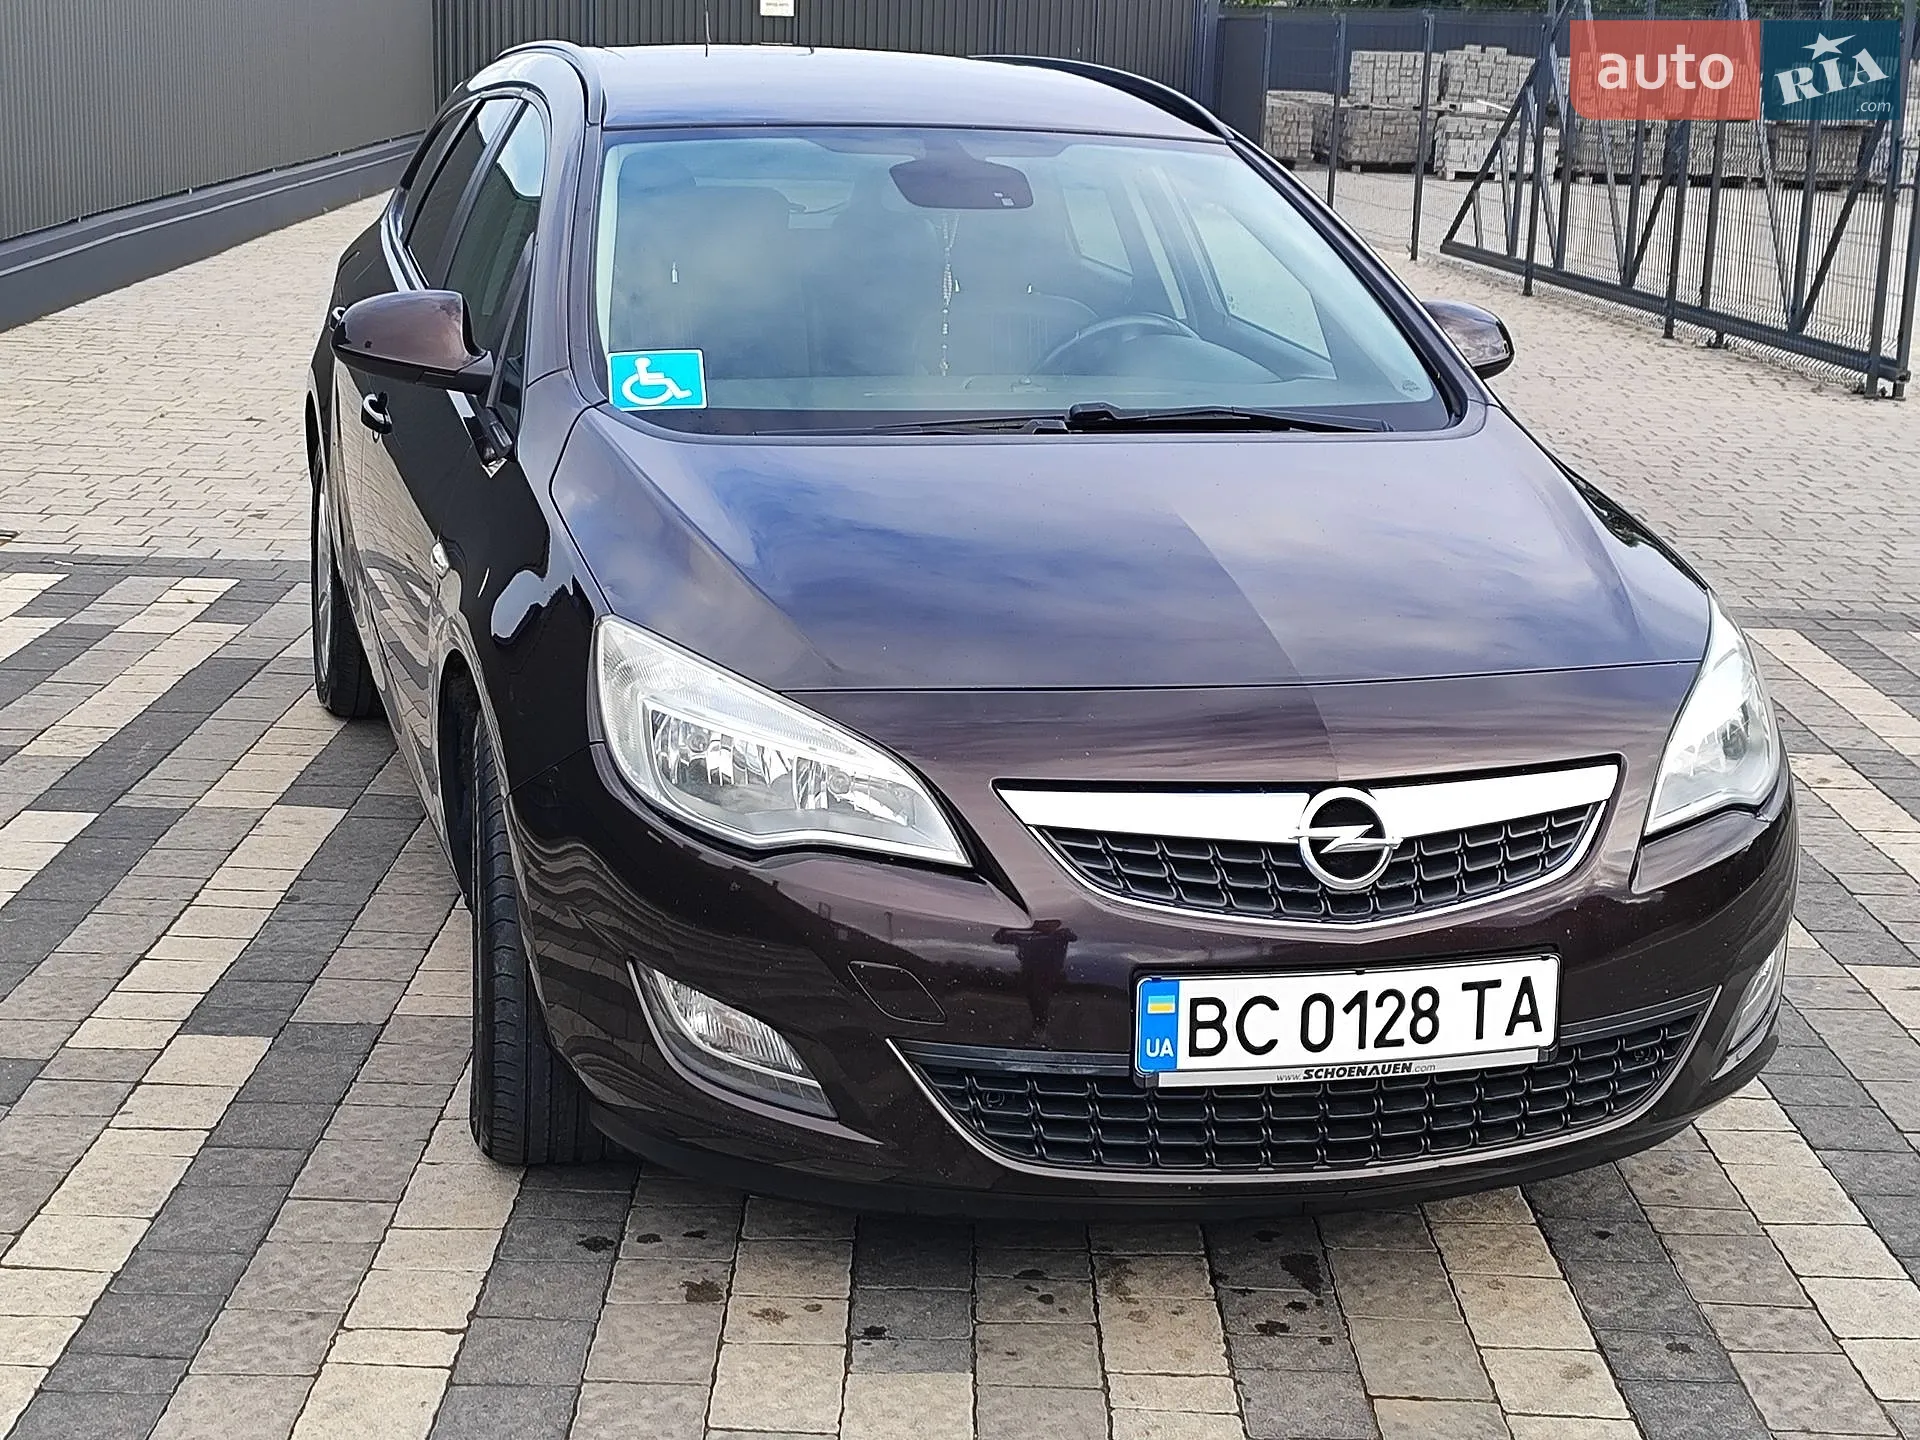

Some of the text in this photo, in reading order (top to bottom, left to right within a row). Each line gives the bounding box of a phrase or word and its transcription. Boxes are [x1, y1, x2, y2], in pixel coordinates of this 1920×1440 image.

[1188, 975, 1543, 1058] BC 0128 TA
[1146, 1037, 1174, 1058] UA
